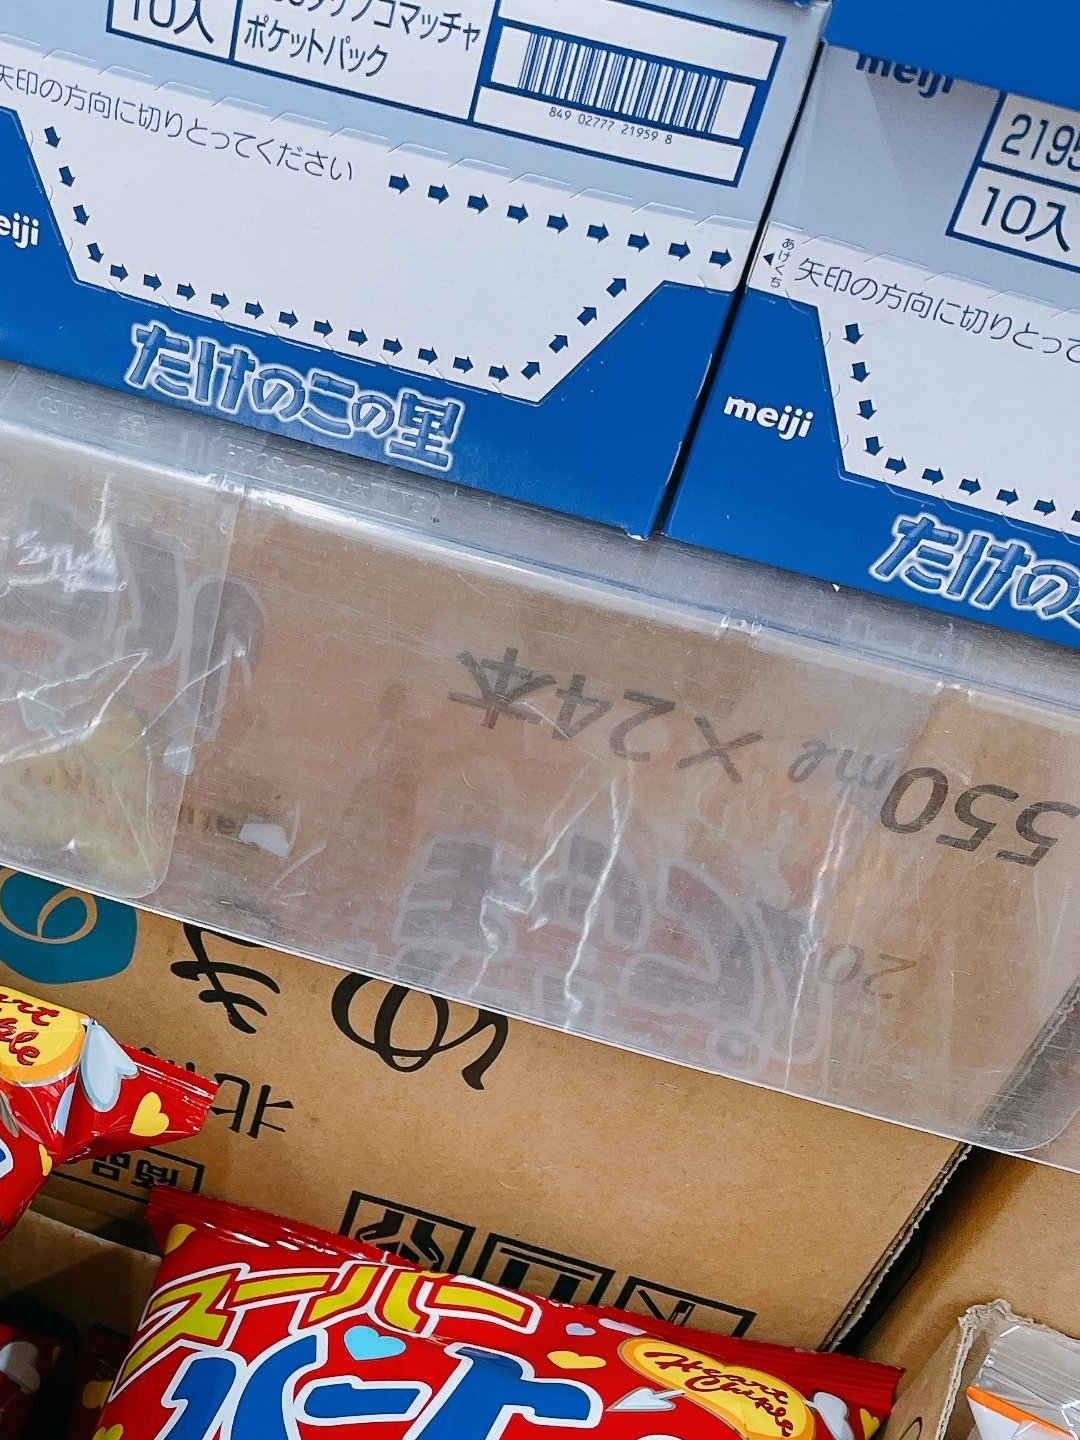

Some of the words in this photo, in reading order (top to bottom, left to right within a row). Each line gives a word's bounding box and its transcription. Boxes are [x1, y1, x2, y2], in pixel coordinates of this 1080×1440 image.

[243, 14, 389, 78] ポケットパック
[980, 185, 1071, 254] 10入
[769, 237, 796, 289] あけくち
[124, 321, 466, 472] たけのこの里
[722, 395, 815, 441] meiji
[110, 1262, 542, 1399] スーパー
[643, 1351, 789, 1405] Heart
